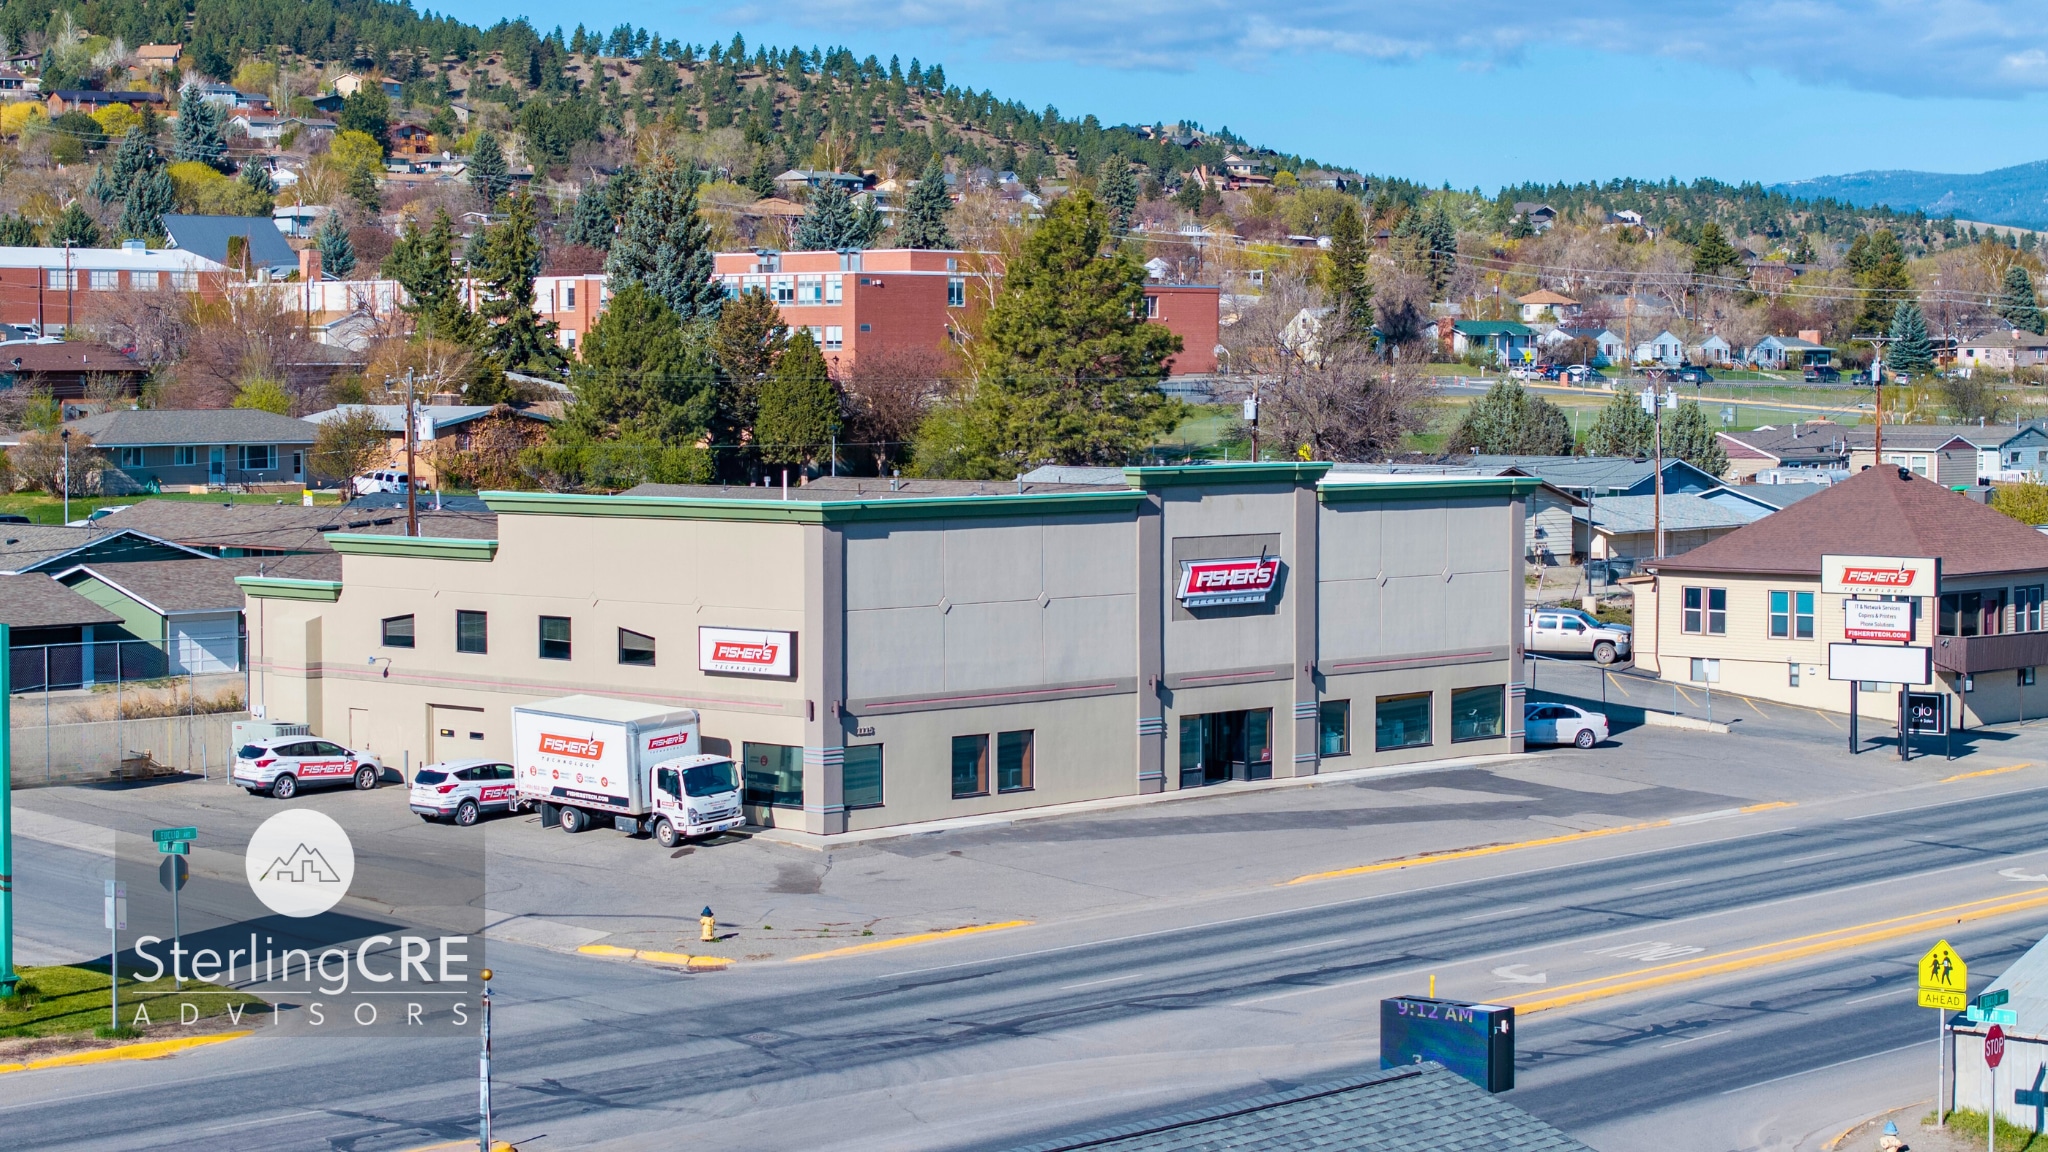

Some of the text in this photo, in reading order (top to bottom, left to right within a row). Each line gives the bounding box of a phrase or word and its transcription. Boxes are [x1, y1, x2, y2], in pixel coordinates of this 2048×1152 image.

[1196, 561, 1272, 588] FISHER'S
[1847, 569, 1910, 584] FISHER'S
[1848, 630, 1907, 639] FISHERSTECH.COM
[718, 643, 772, 661] FISHER'S
[543, 738, 599, 756] FISHER'S
[651, 733, 685, 748] FISHER'S
[302, 760, 353, 774] FISHER'S
[1925, 994, 1960, 1006] AHEAD
[1397, 1001, 1473, 1023] 9:12 AM
[1986, 1038, 2004, 1056] STOP
